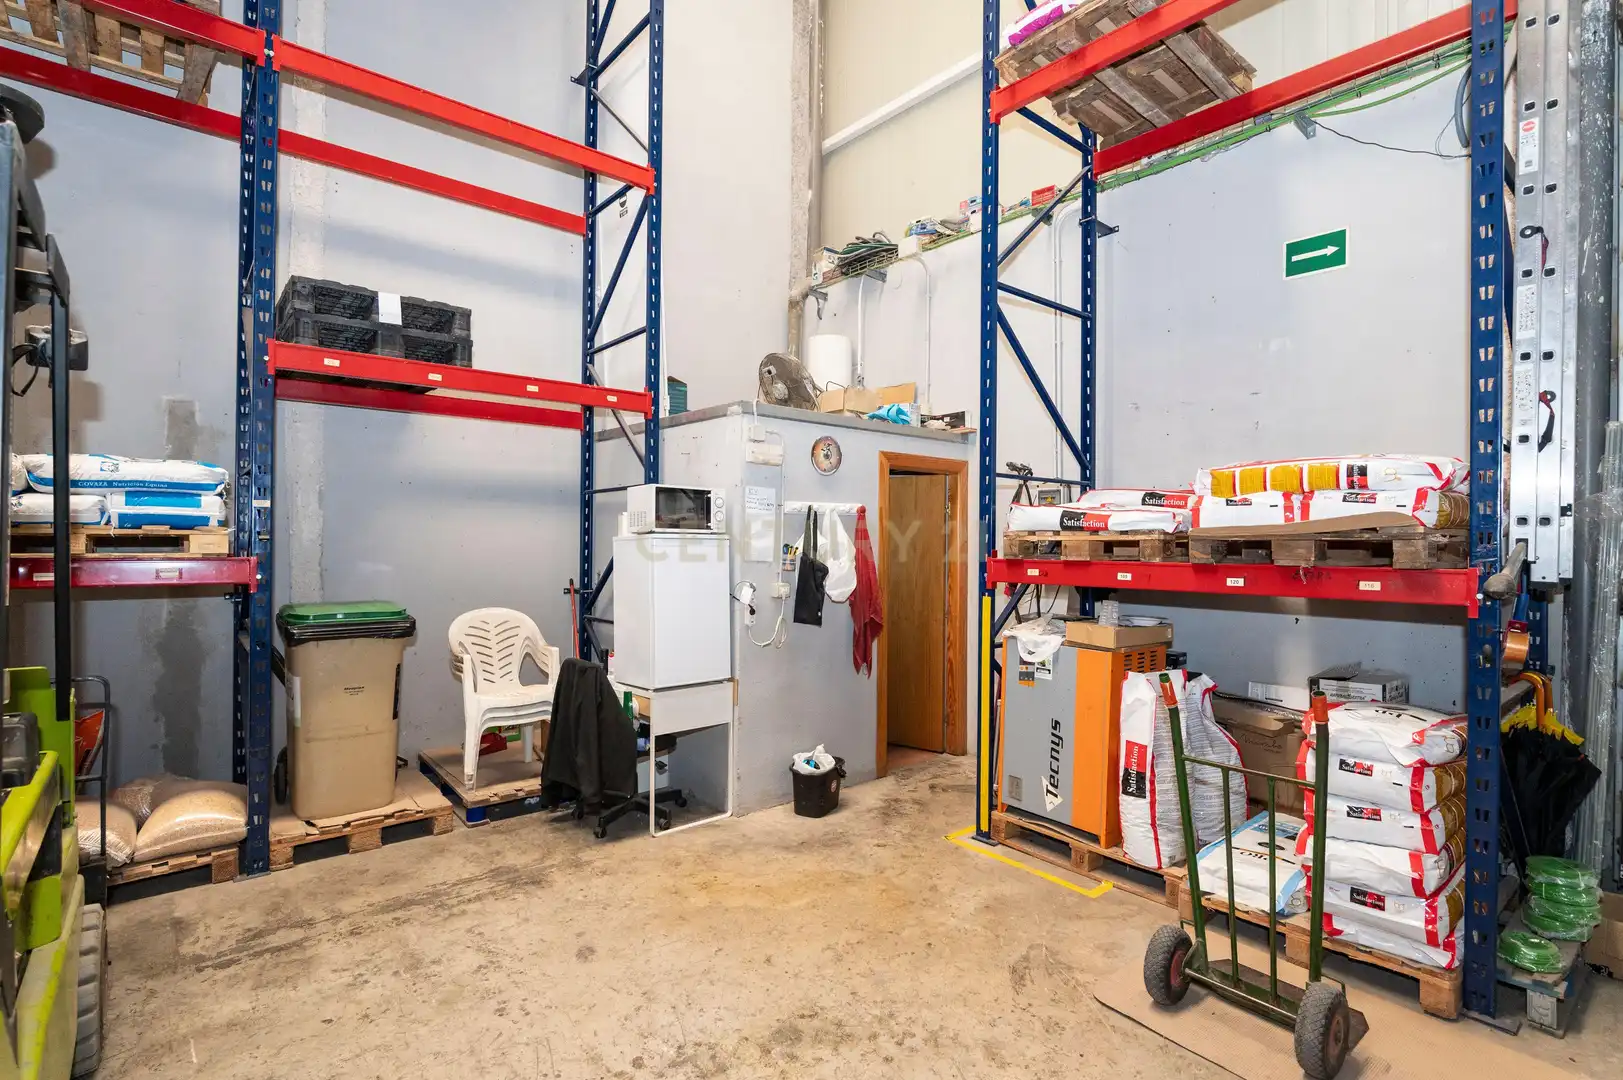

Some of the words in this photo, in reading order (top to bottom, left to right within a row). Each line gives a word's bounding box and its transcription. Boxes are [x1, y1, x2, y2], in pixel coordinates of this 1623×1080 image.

[1144, 496, 1185, 506] Satisfaction
[1063, 516, 1105, 528] Satisfaction
[1045, 717, 1064, 799] Tecnys
[1127, 745, 1139, 794] Satisfaction
[1341, 764, 1372, 775] Satisfaction
[1349, 810, 1381, 821] Satisfaction
[1352, 892, 1384, 907] Satisfaction
